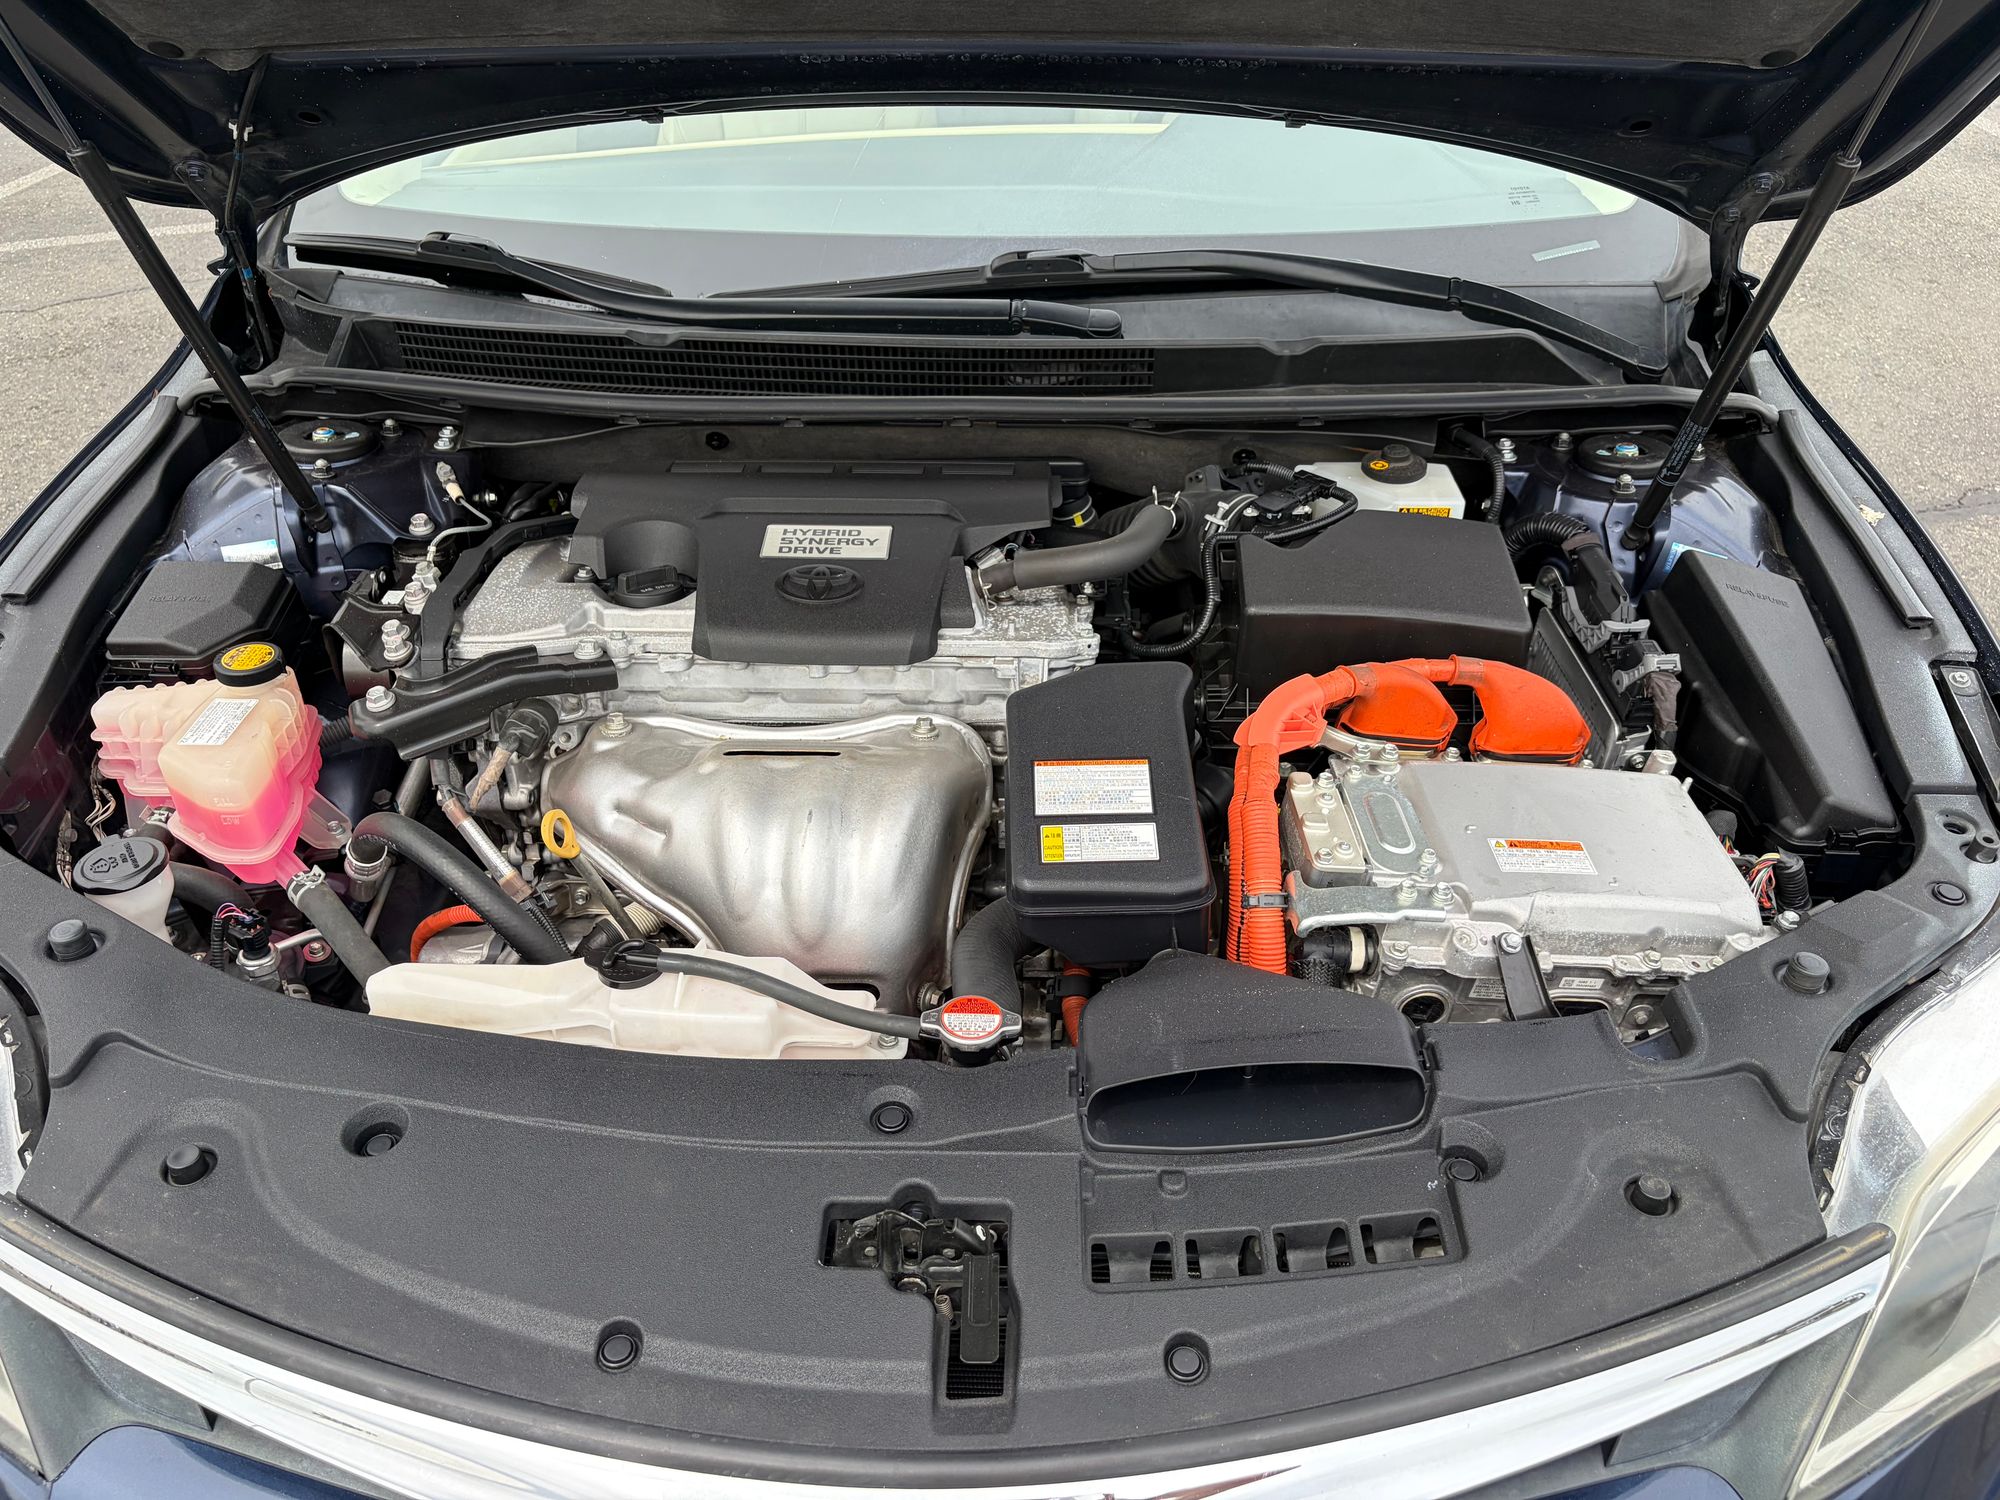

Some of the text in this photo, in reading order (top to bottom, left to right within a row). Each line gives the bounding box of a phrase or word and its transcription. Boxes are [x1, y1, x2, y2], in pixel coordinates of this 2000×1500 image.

[782, 528, 862, 537] HYBRID
[779, 537, 880, 546] SYNERGY
[778, 545, 842, 555] DRIVE
